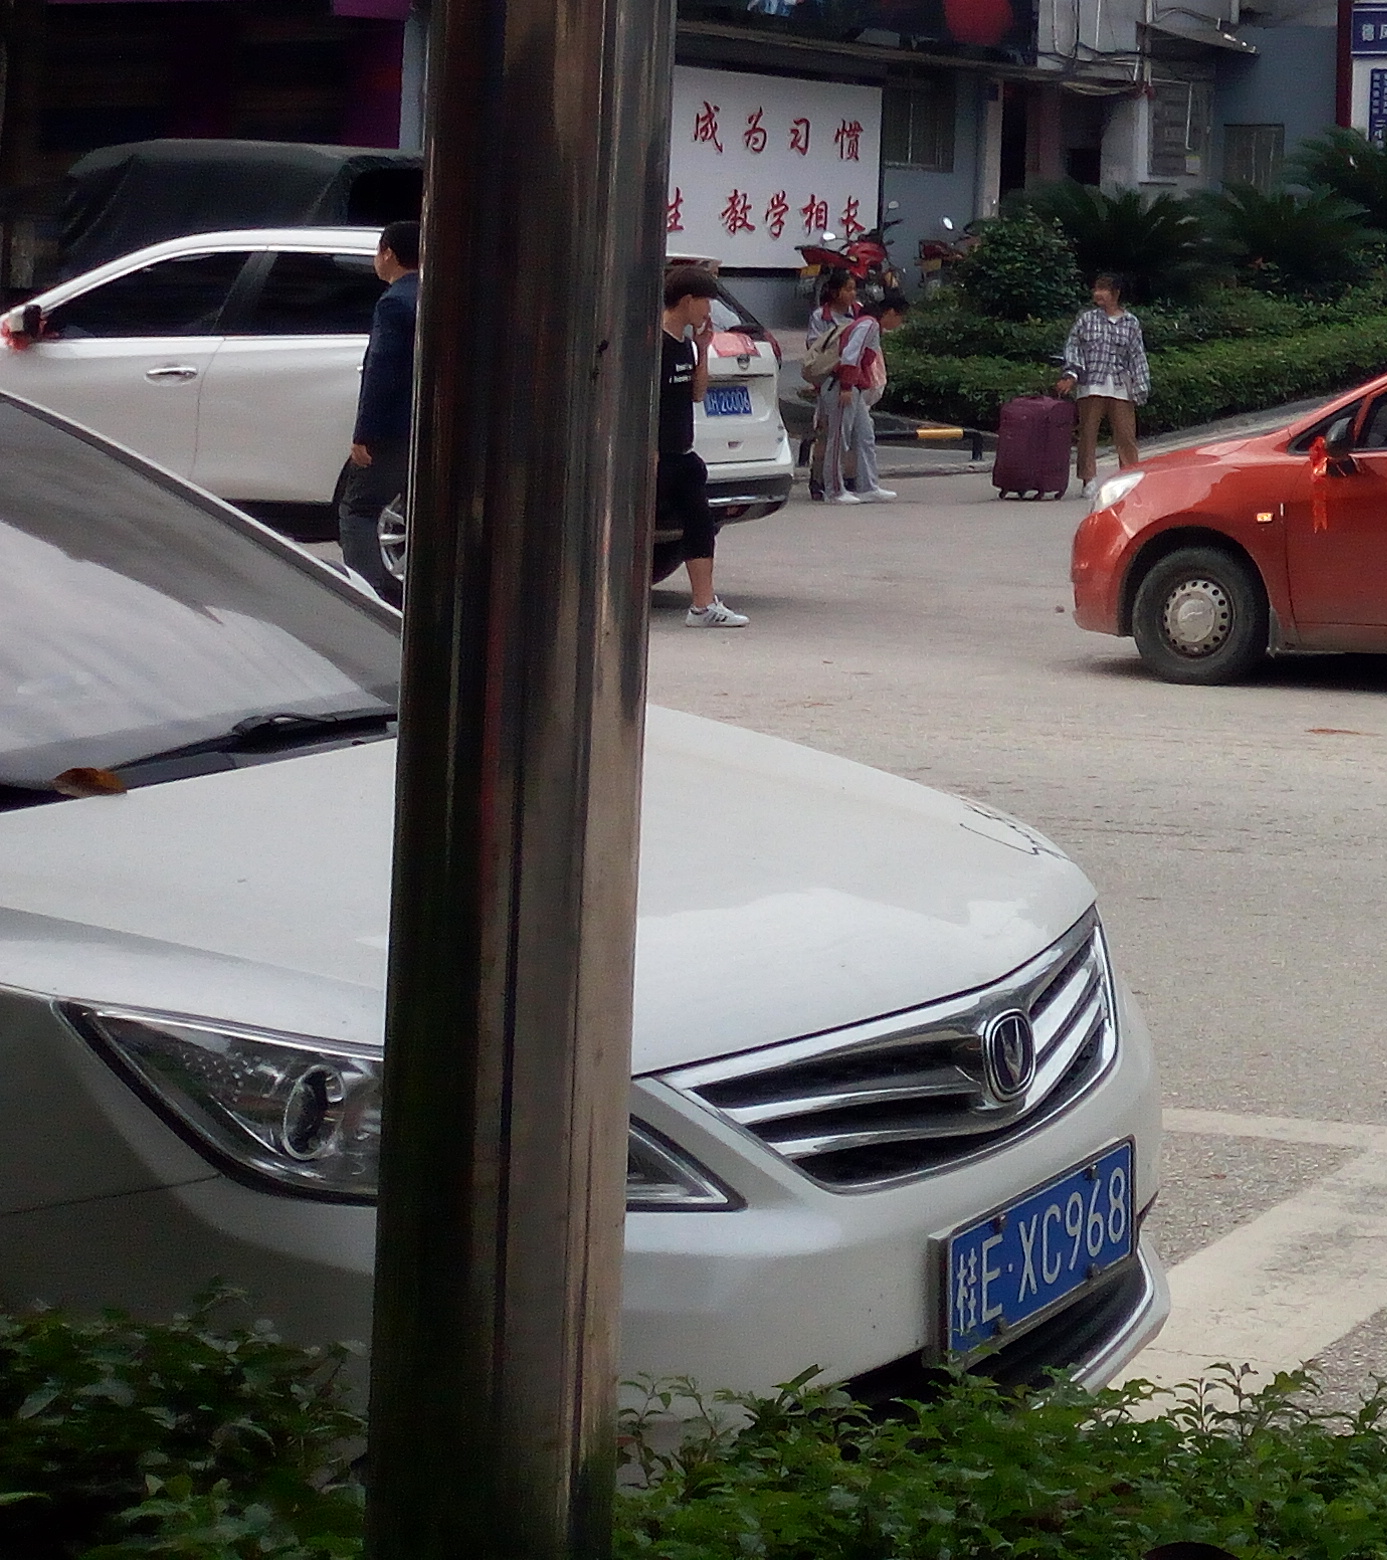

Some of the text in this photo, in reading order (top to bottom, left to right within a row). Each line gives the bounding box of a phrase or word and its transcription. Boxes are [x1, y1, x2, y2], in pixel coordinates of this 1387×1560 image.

[692, 101, 864, 163] 成为习惯
[720, 188, 867, 239] 教学相长
